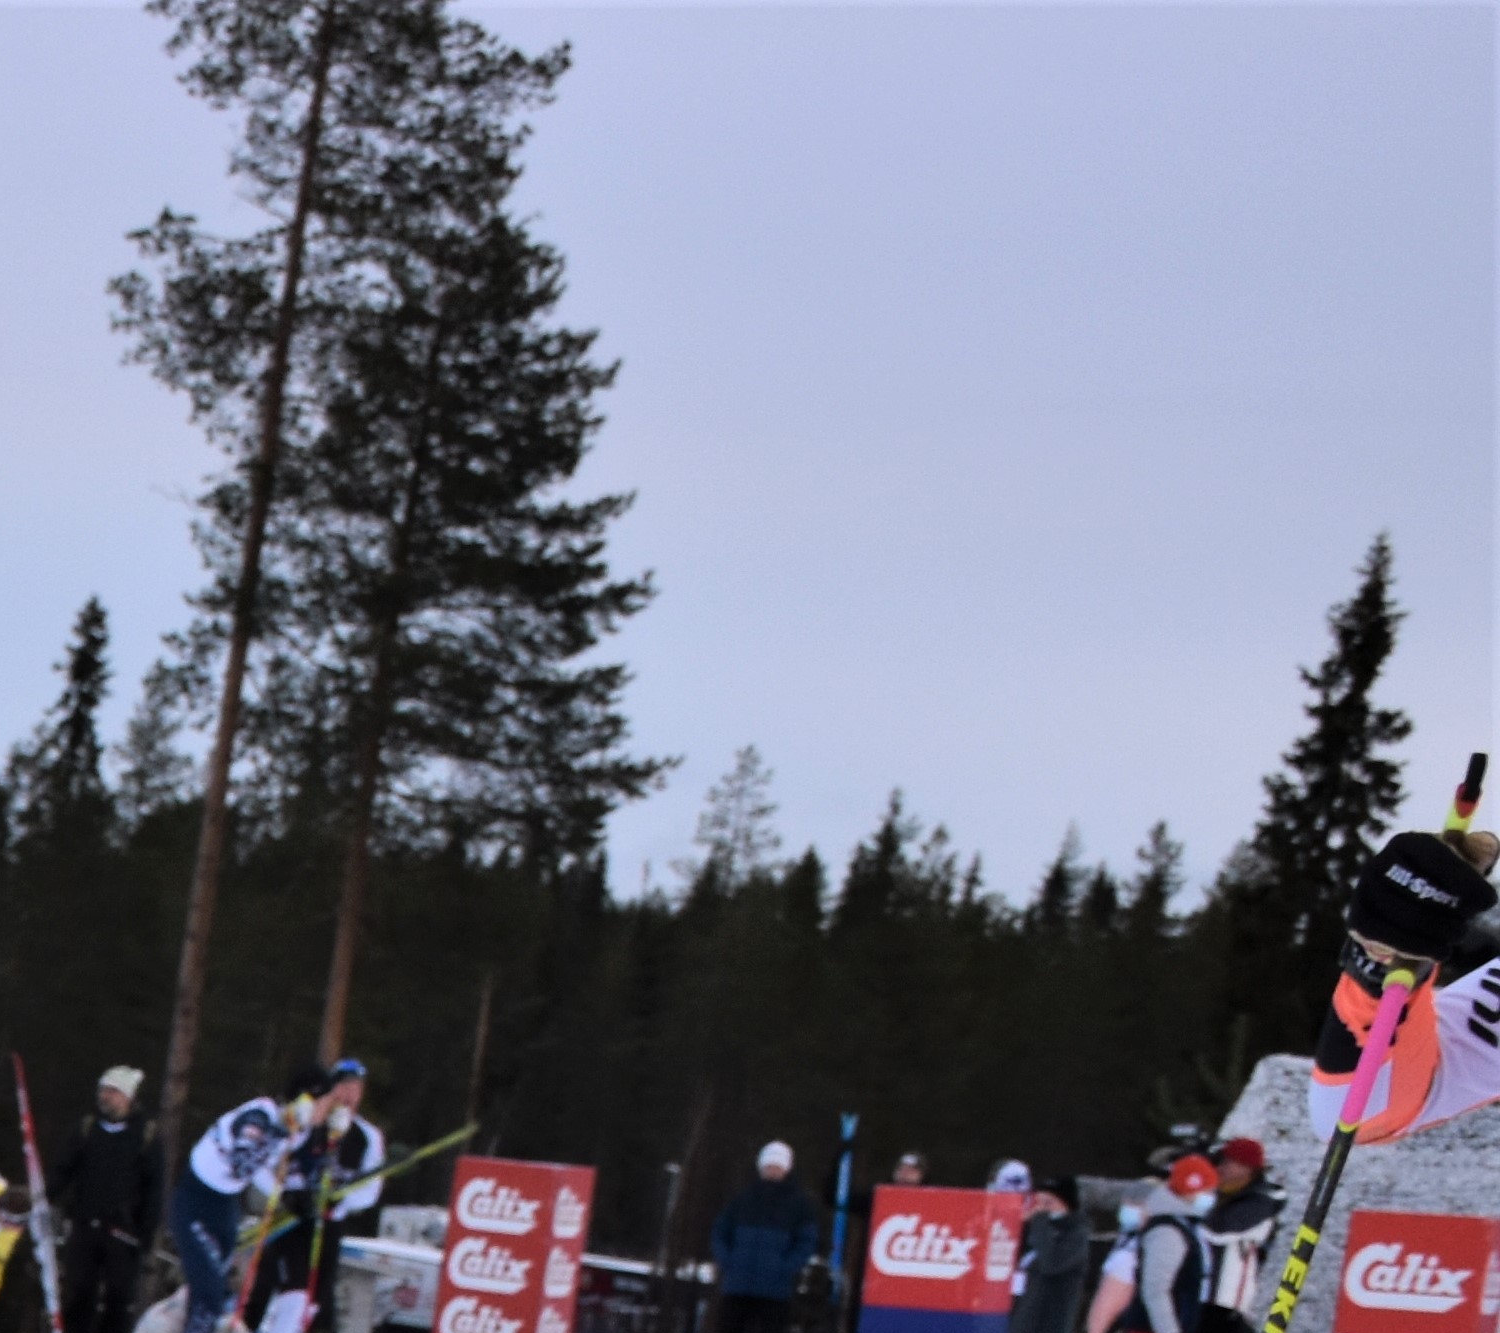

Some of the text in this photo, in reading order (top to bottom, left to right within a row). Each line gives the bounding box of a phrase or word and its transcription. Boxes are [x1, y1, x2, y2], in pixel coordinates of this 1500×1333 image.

[456, 1177, 541, 1236] Calix
[447, 1236, 534, 1295] Calix
[870, 1214, 978, 1281] Calix
[1343, 1241, 1475, 1314] Calix
